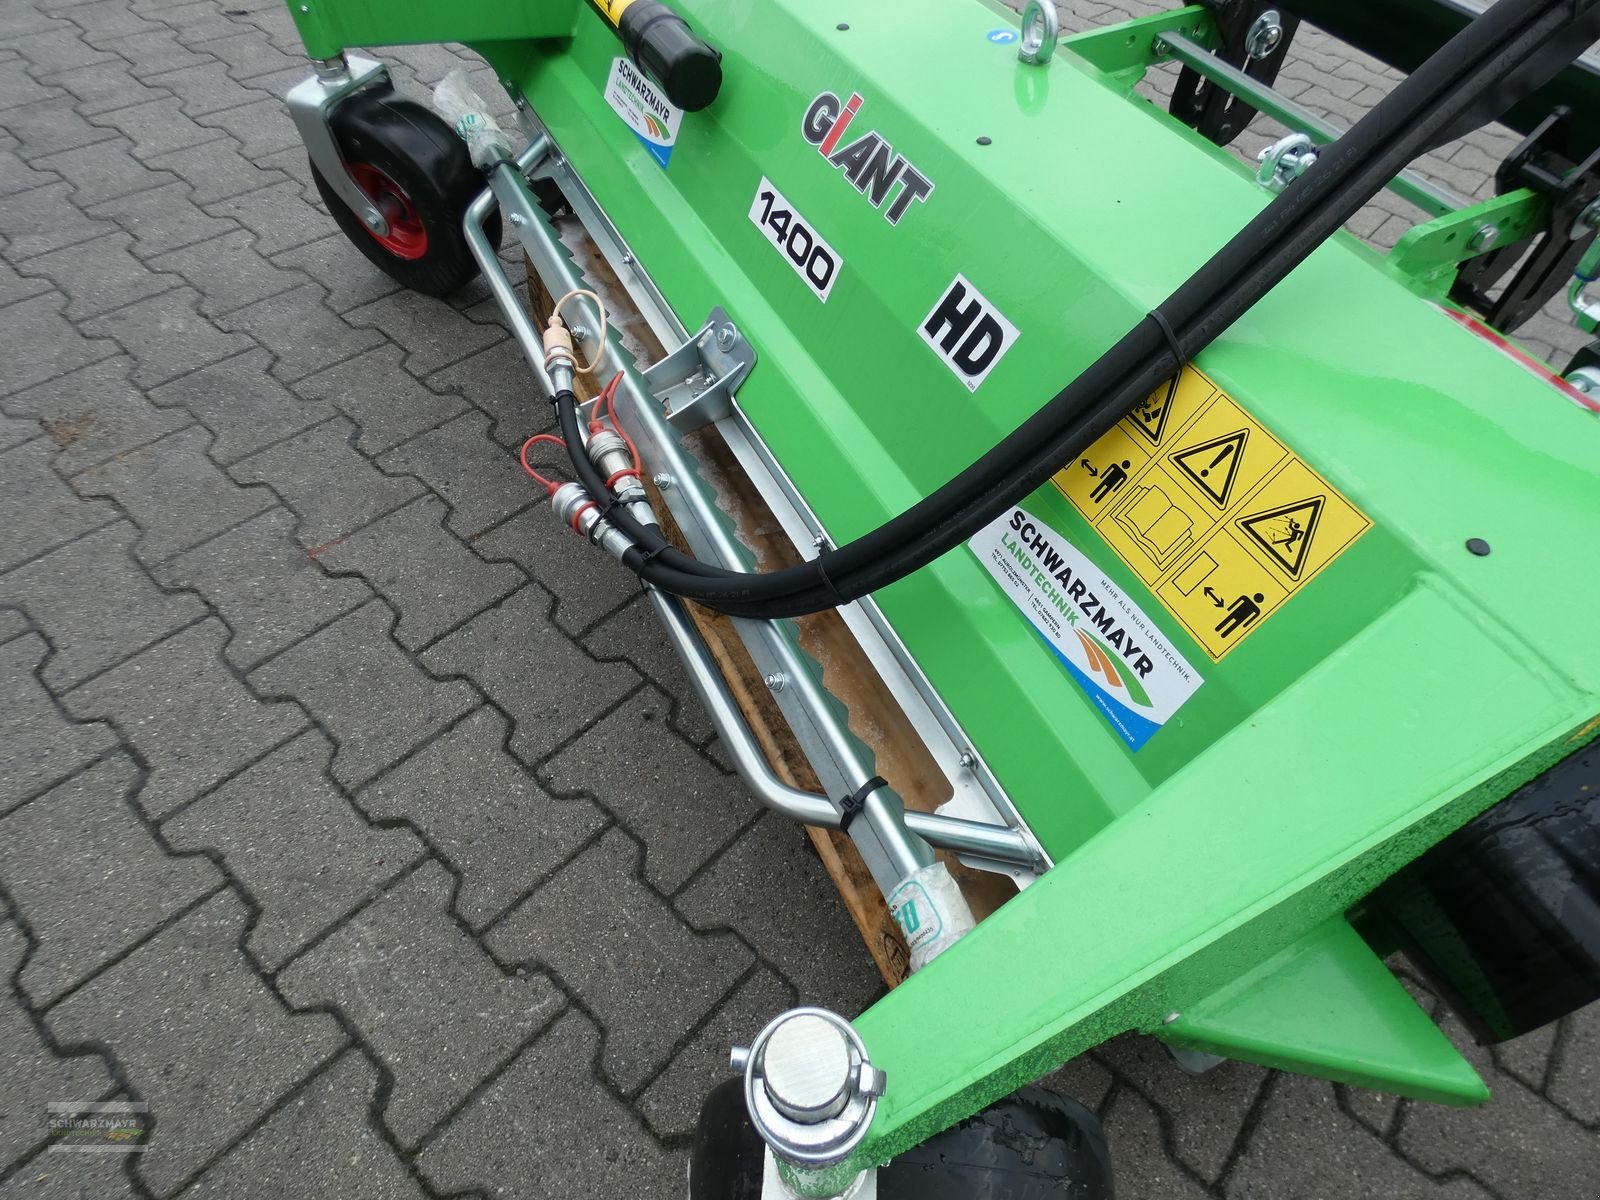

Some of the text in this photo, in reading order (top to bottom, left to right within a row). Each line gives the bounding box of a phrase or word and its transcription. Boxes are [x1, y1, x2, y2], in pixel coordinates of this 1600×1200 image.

[618, 60, 670, 123] SCHWARZMAYR
[760, 191, 835, 291] 1400
[924, 280, 1004, 378] HD
[1001, 532, 1080, 627] LANDTECHNIK
[1009, 510, 1154, 679] SCHWARZMAYR
[1100, 579, 1190, 683] MEHR ALS NUR LANDTECHNIK.
